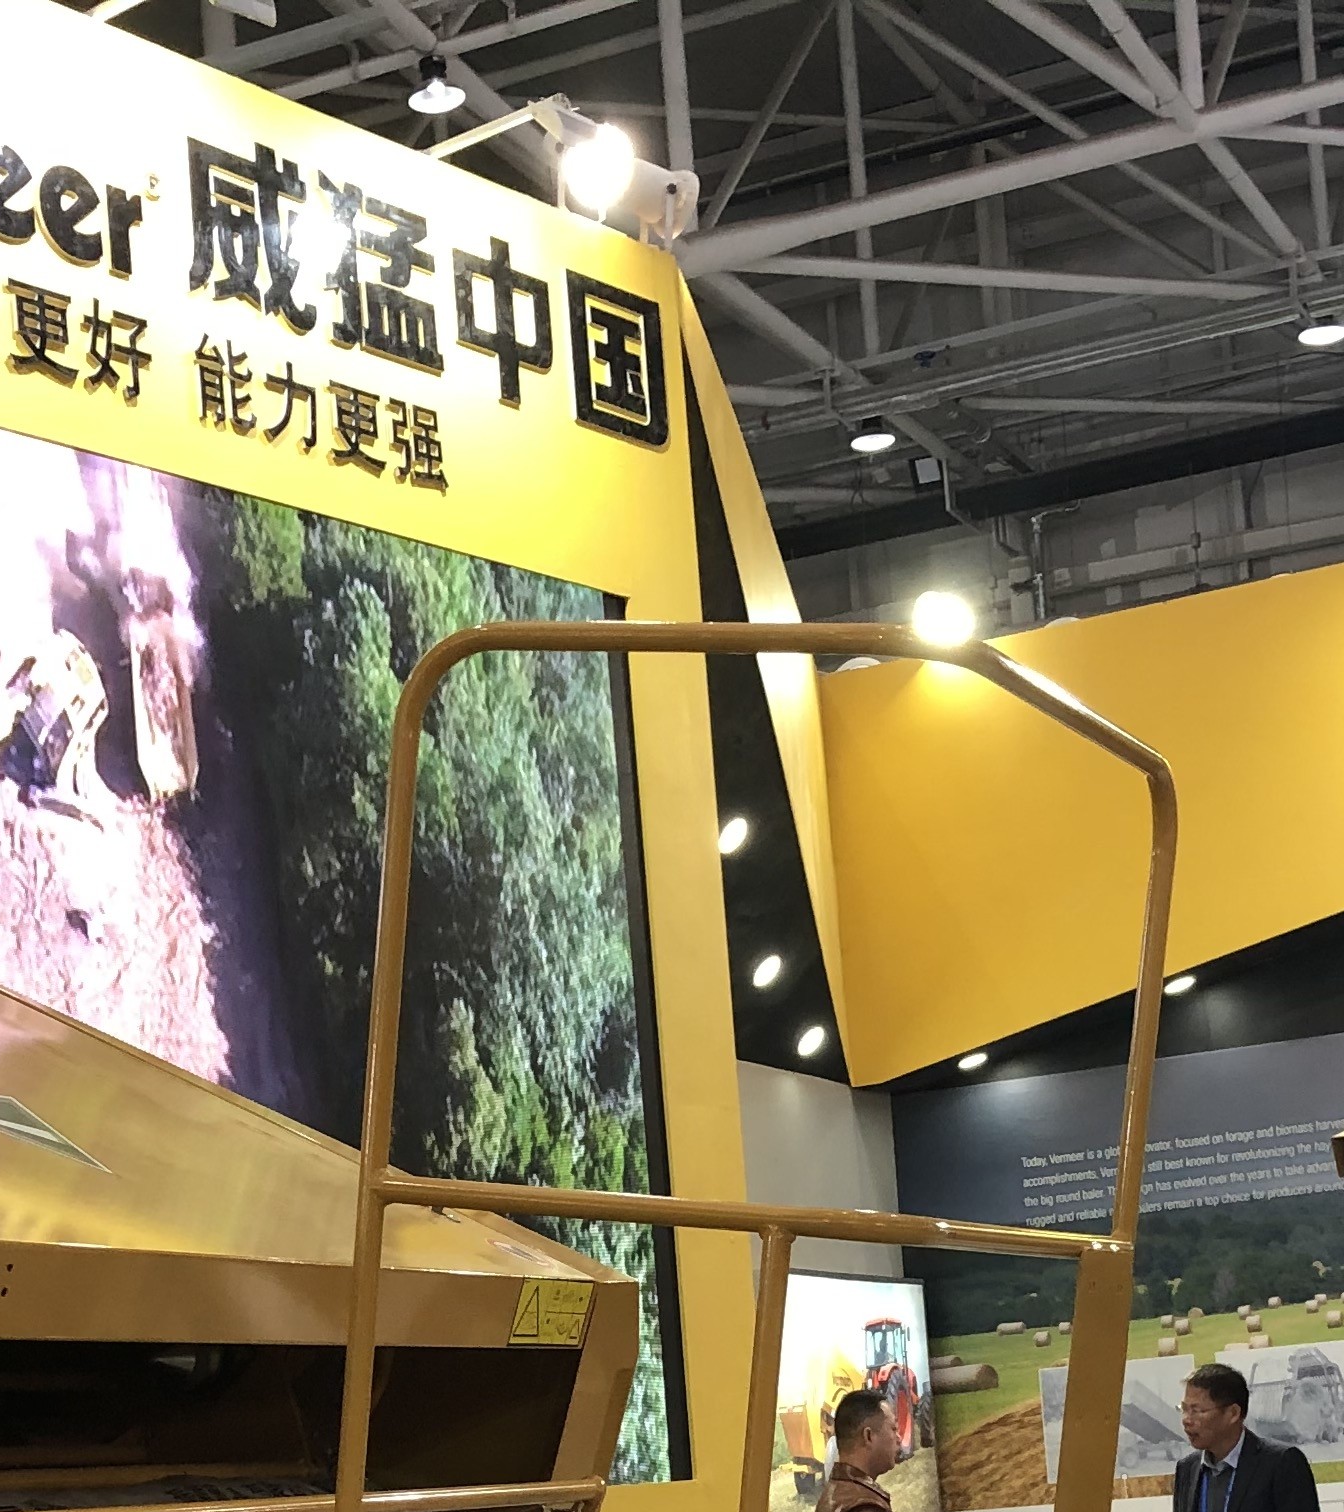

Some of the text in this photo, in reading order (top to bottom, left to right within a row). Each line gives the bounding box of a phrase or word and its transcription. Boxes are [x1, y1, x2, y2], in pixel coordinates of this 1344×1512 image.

[187, 136, 670, 452] 威猛中国
[193, 332, 449, 496] 能力更强
[1256, 1126, 1274, 1139] and
[1057, 1210, 1075, 1224] and
